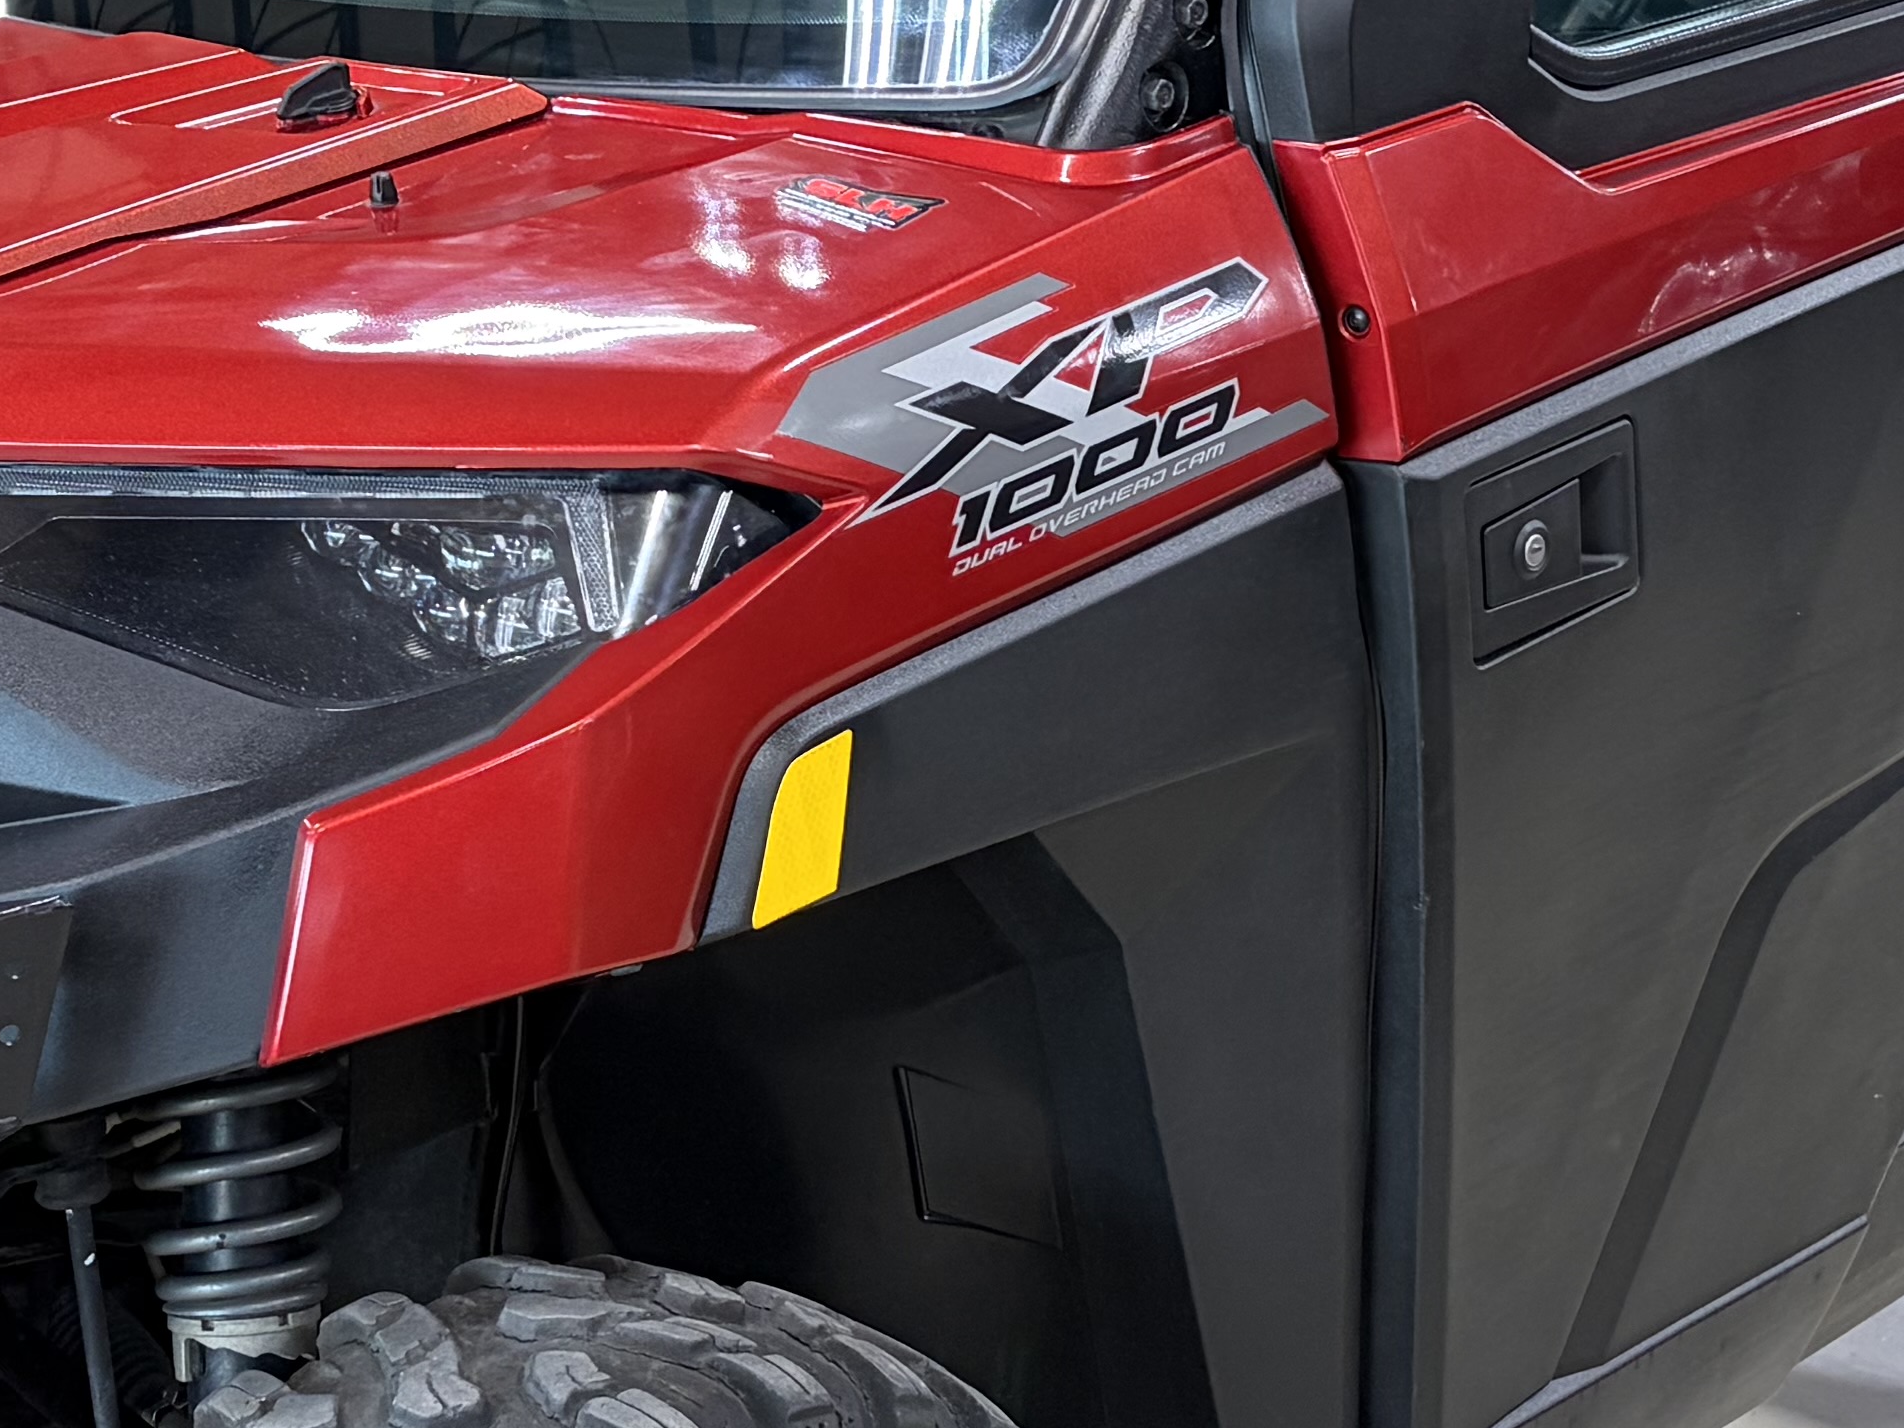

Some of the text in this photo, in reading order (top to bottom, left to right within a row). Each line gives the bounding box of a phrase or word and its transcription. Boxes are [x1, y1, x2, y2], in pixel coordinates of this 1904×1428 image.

[843, 257, 1269, 532] XP
[949, 378, 1241, 559] 1000
[952, 440, 1226, 577] DUAL OVERHEAD CAM
